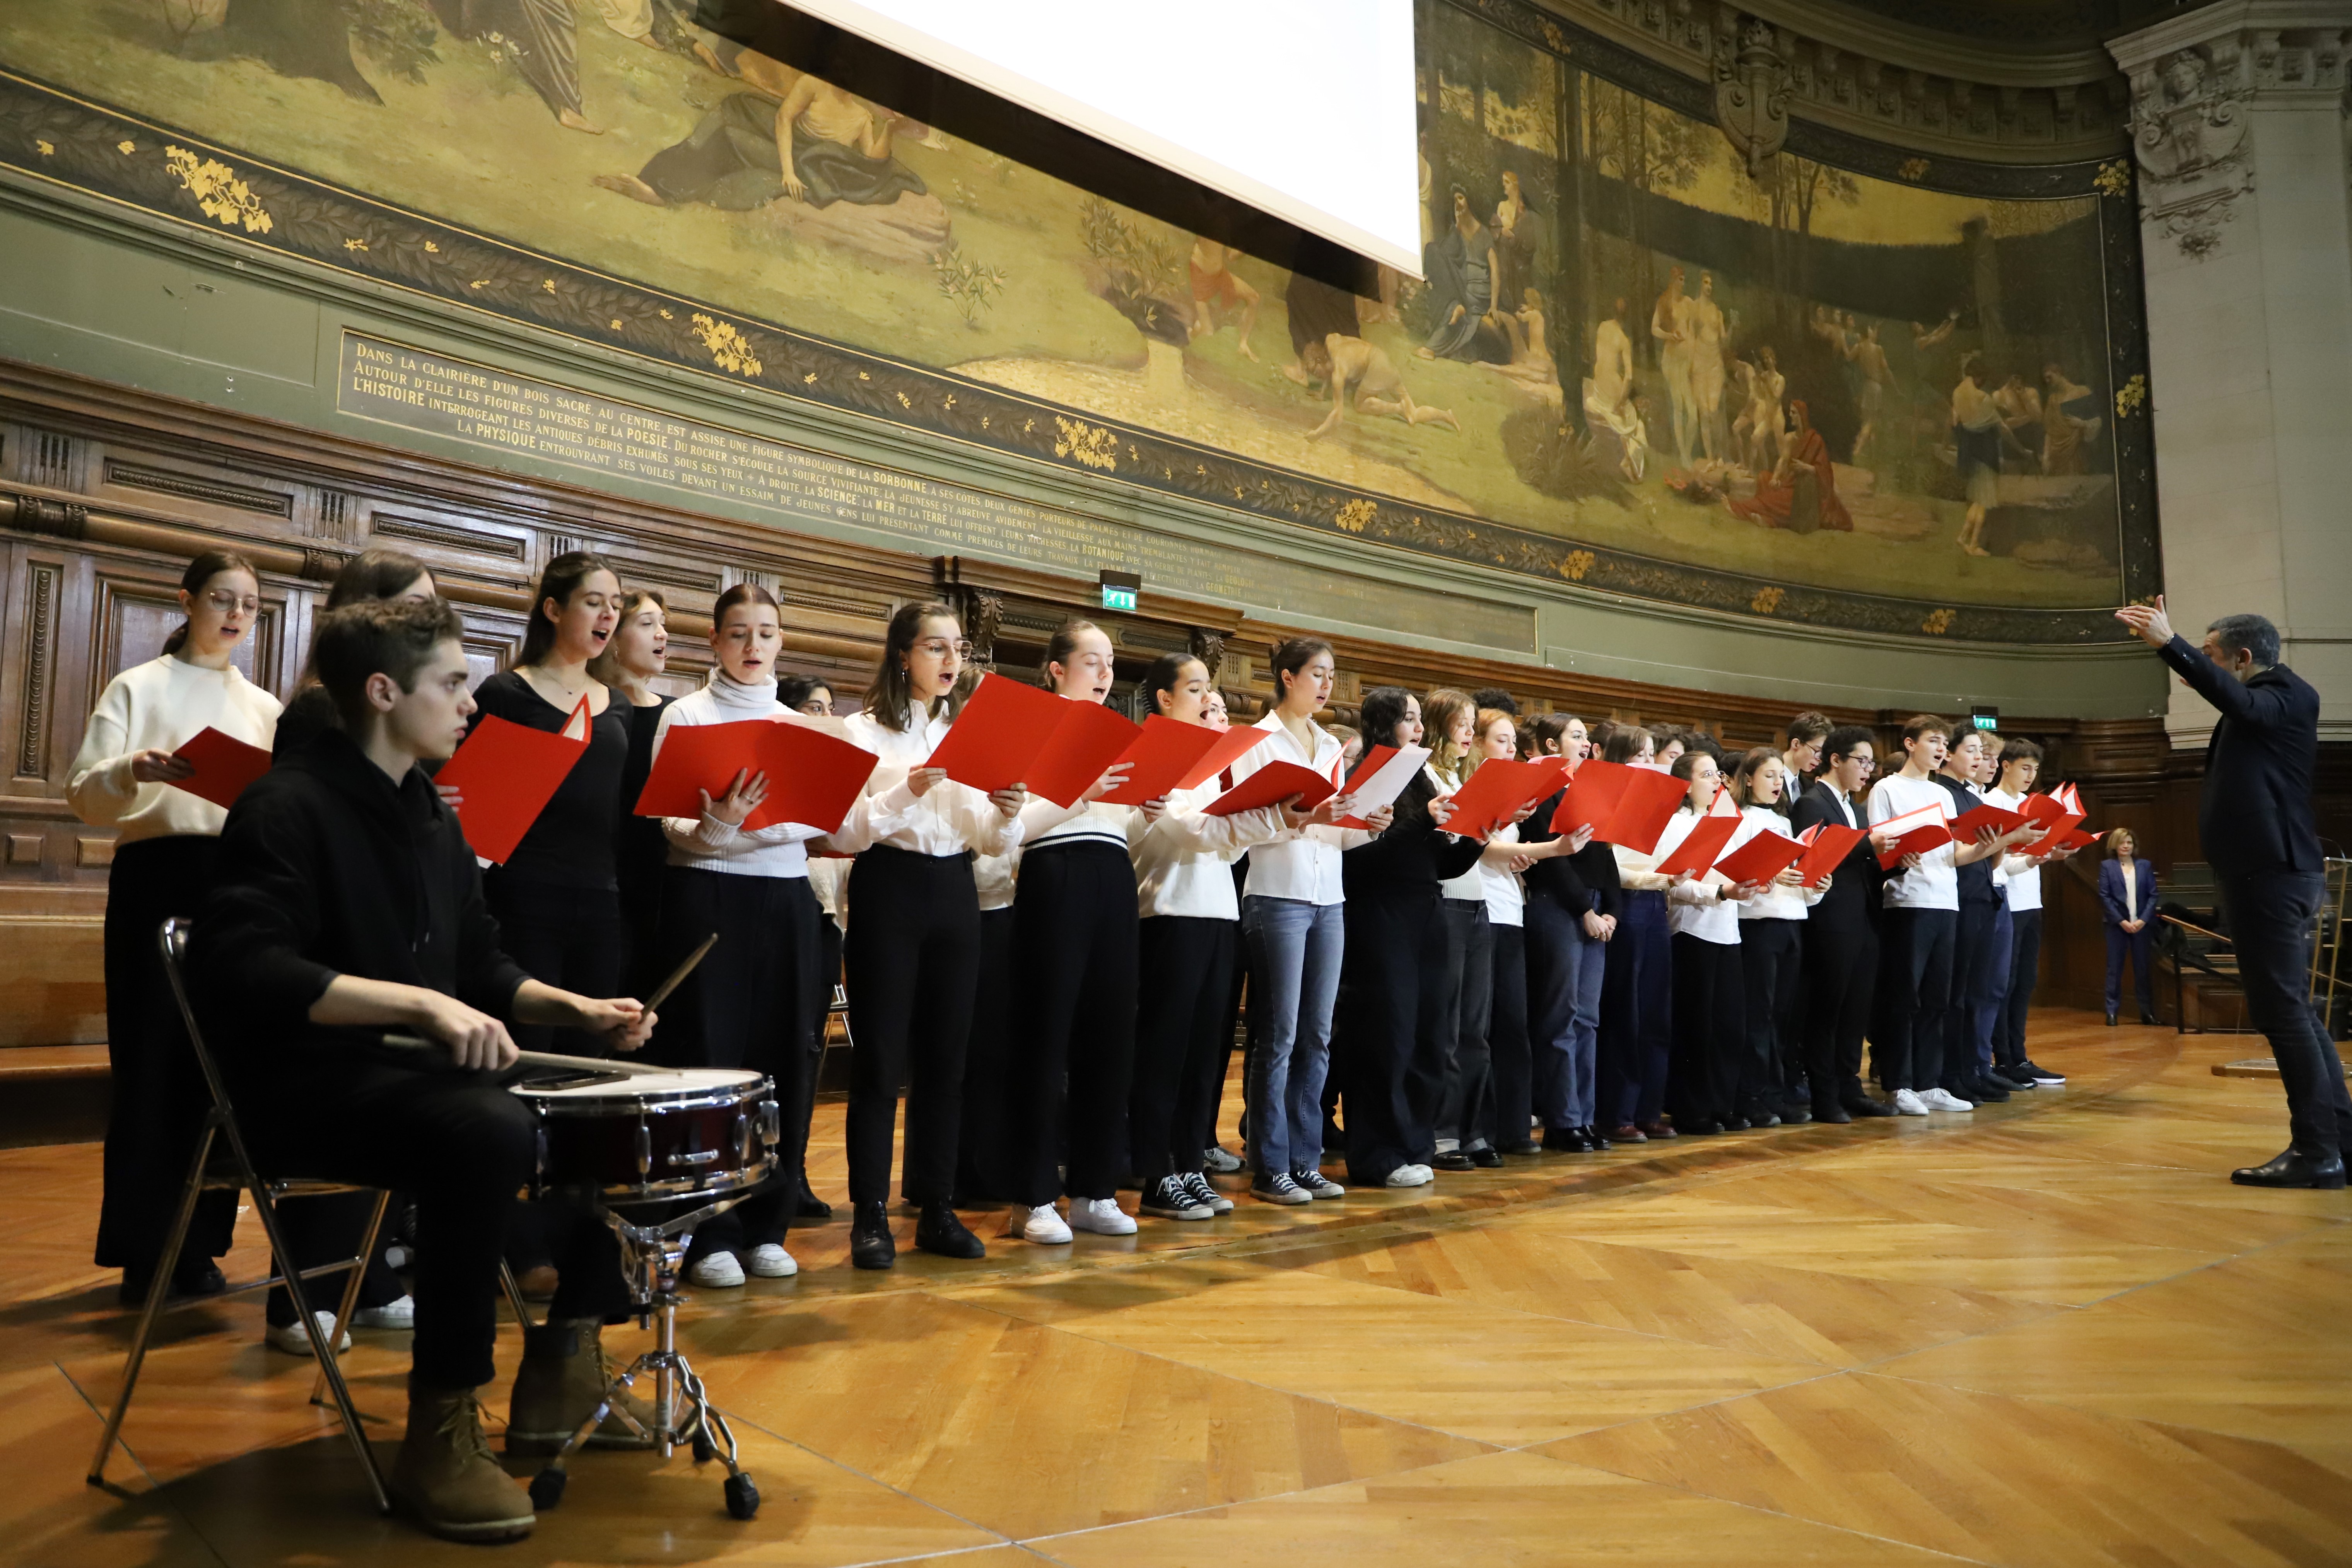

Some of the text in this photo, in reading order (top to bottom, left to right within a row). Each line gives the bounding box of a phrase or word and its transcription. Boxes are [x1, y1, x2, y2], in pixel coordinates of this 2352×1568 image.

[353, 360, 407, 386] AUTOUR
[414, 377, 453, 397] D'ELLE
[458, 387, 479, 403] LES
[484, 394, 533, 416] FIGURES
[538, 408, 589, 430] DIVERSES
[595, 421, 608, 434] DE
[611, 425, 623, 438] LA
[675, 439, 688, 453] DU
[690, 444, 727, 462] ROCHER
[732, 454, 774, 473] S'ÉCOULE
[777, 465, 788, 476] LA
[792, 468, 827, 485] SOURCE
[885, 490, 895, 500] LA
[900, 493, 939, 510] JEUNESSE
[957, 505, 991, 521] ABREUVE
[1042, 525, 1052, 534] LA
[1053, 527, 1094, 543] VIEILLESSE
[1097, 537, 1112, 547] AUX
[1114, 540, 1137, 553] MAINS
[1140, 546, 1187, 563] TREMBLANTES
[354, 376, 425, 406] L'HISTOIRE
[429, 397, 509, 427] INTERROGEANT
[512, 417, 531, 432] LES
[535, 422, 582, 444] ANTIQUES
[587, 435, 622, 454] DÉBRIS
[626, 445, 668, 464] EXHUMÉS
[674, 456, 698, 471] SOUS
[701, 462, 717, 475] SES
[720, 466, 743, 481] YEUX
[758, 473, 765, 486] A
[769, 478, 801, 494] DROITE,
[804, 485, 815, 497] LA
[863, 498, 872, 509] LA
[875, 498, 894, 514] MER
[898, 506, 907, 516] ET
[910, 509, 919, 519] LA
[922, 509, 947, 525] TERRE
[950, 517, 962, 528] LUI
[965, 521, 996, 535] OFFRENT
[1001, 529, 1023, 541] LEURS
[1070, 543, 1079, 552] LA
[1082, 544, 1124, 562] BOTANIQUE
[1126, 555, 1141, 565] AVEC
[1144, 559, 1153, 568] SA
[1177, 566, 1184, 574] DE
[356, 341, 393, 365] DANS
[401, 356, 416, 371] LA
[422, 361, 487, 389] CLAIRIÈRE
[493, 380, 518, 396] D'UN
[524, 388, 549, 404] BOIS
[556, 396, 594, 416] SACRÉ,
[598, 406, 613, 421] AU
[620, 412, 664, 433] CENTRE,
[667, 423, 686, 438] EST
[690, 429, 726, 448] ASSISE
[729, 439, 748, 452] UNE
[753, 444, 784, 461] FIGURE
[787, 452, 843, 475] SYMBOLIQUE
[846, 466, 856, 478] DE
[859, 469, 870, 481] LA
[931, 486, 936, 496] A
[939, 489, 953, 500] SES
[985, 499, 1004, 511] DEUX
[1008, 503, 1035, 518] GÉNIES
[1039, 511, 1074, 527] PORTEURS
[1077, 519, 1086, 529] DE
[1090, 522, 1118, 536] PALMES
[1122, 530, 1131, 539] ET
[1134, 532, 1143, 541] DE
[1146, 535, 1187, 551] COURONNES
[457, 419, 472, 434] LA
[476, 422, 536, 449] PHYSIQUE
[540, 440, 610, 466] ENTROUVRANT
[617, 458, 635, 471] SES
[639, 463, 675, 480] VOILES
[682, 472, 717, 490] DEVANT
[722, 482, 735, 493] UN
[740, 486, 774, 502] ESSAIM
[780, 494, 791, 505] DE
[796, 498, 831, 514] JEUNES
[836, 507, 857, 519] GENS
[861, 512, 875, 523] LUI
[934, 527, 962, 541] COMME
[968, 534, 1003, 549] PRÉMICES
[1007, 542, 1016, 552] DE
[1019, 545, 1042, 557] LEURS
[1048, 551, 1078, 565] TRAVAUX
[1084, 559, 1093, 568] LA
[1097, 561, 1126, 573] FLAMME
